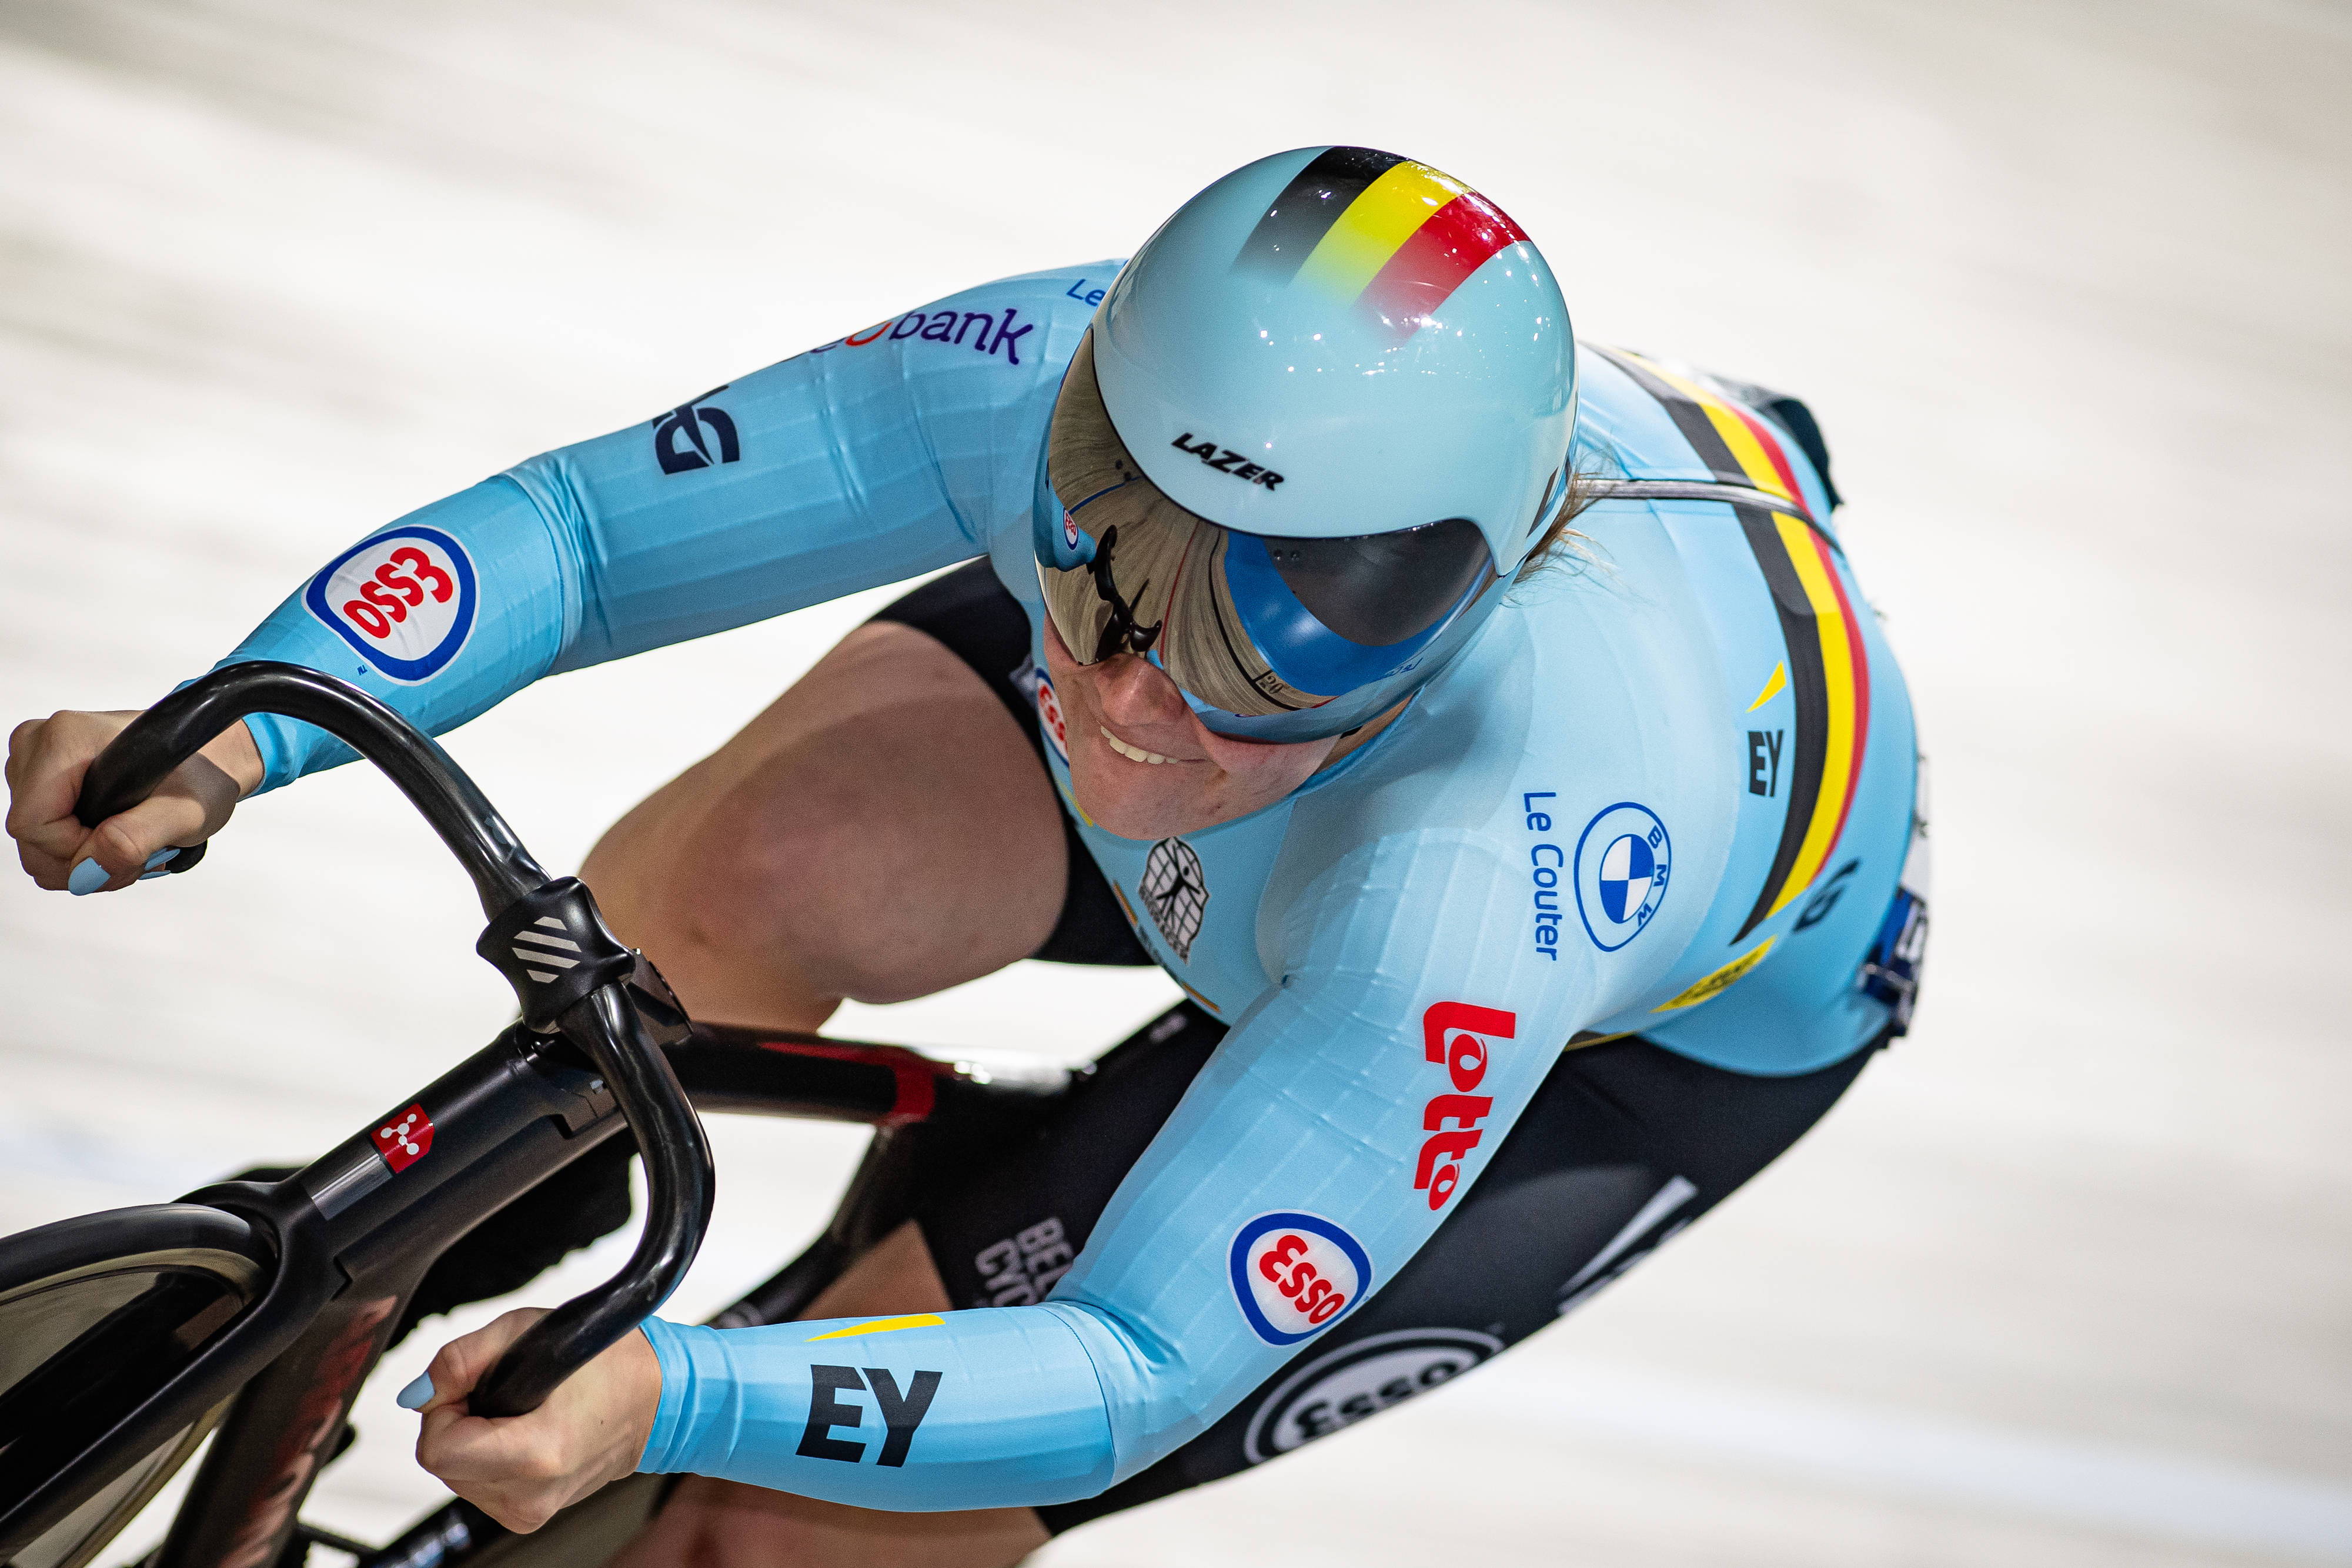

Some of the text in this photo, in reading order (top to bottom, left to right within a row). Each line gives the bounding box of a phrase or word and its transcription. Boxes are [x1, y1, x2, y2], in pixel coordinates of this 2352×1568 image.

[1066, 279, 1106, 307] Le
[1171, 432, 1284, 491] LAZER
[343, 547, 453, 638] Esso
[1748, 729, 1783, 797] EY
[1524, 792, 1564, 961] Le Couter
[1637, 825, 1668, 927] BMW
[1259, 1235, 1345, 1324] Esso
[795, 1364, 943, 1468] EY
